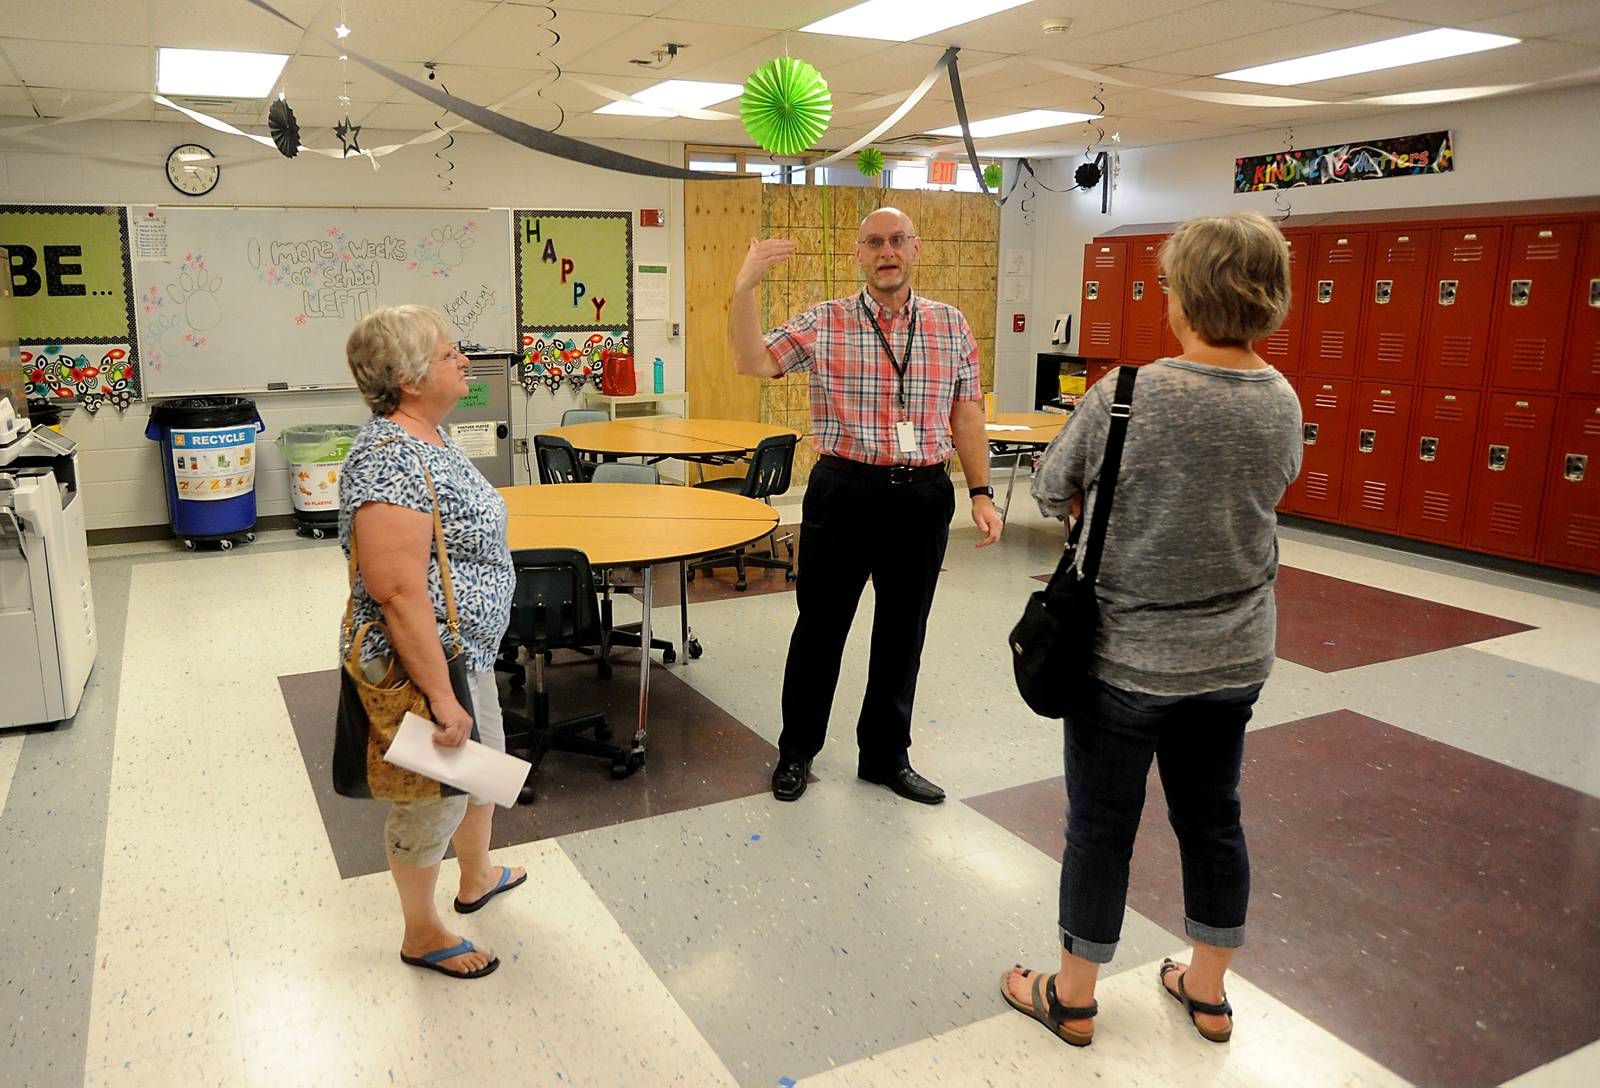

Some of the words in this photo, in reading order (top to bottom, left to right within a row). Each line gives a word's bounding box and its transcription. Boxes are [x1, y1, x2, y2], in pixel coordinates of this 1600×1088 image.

[932, 161, 956, 182] EXIT
[271, 240, 334, 266] more
[291, 267, 311, 286] of
[323, 260, 380, 288] School
[443, 290, 469, 316] Keep
[192, 432, 246, 445] RECYCLE
